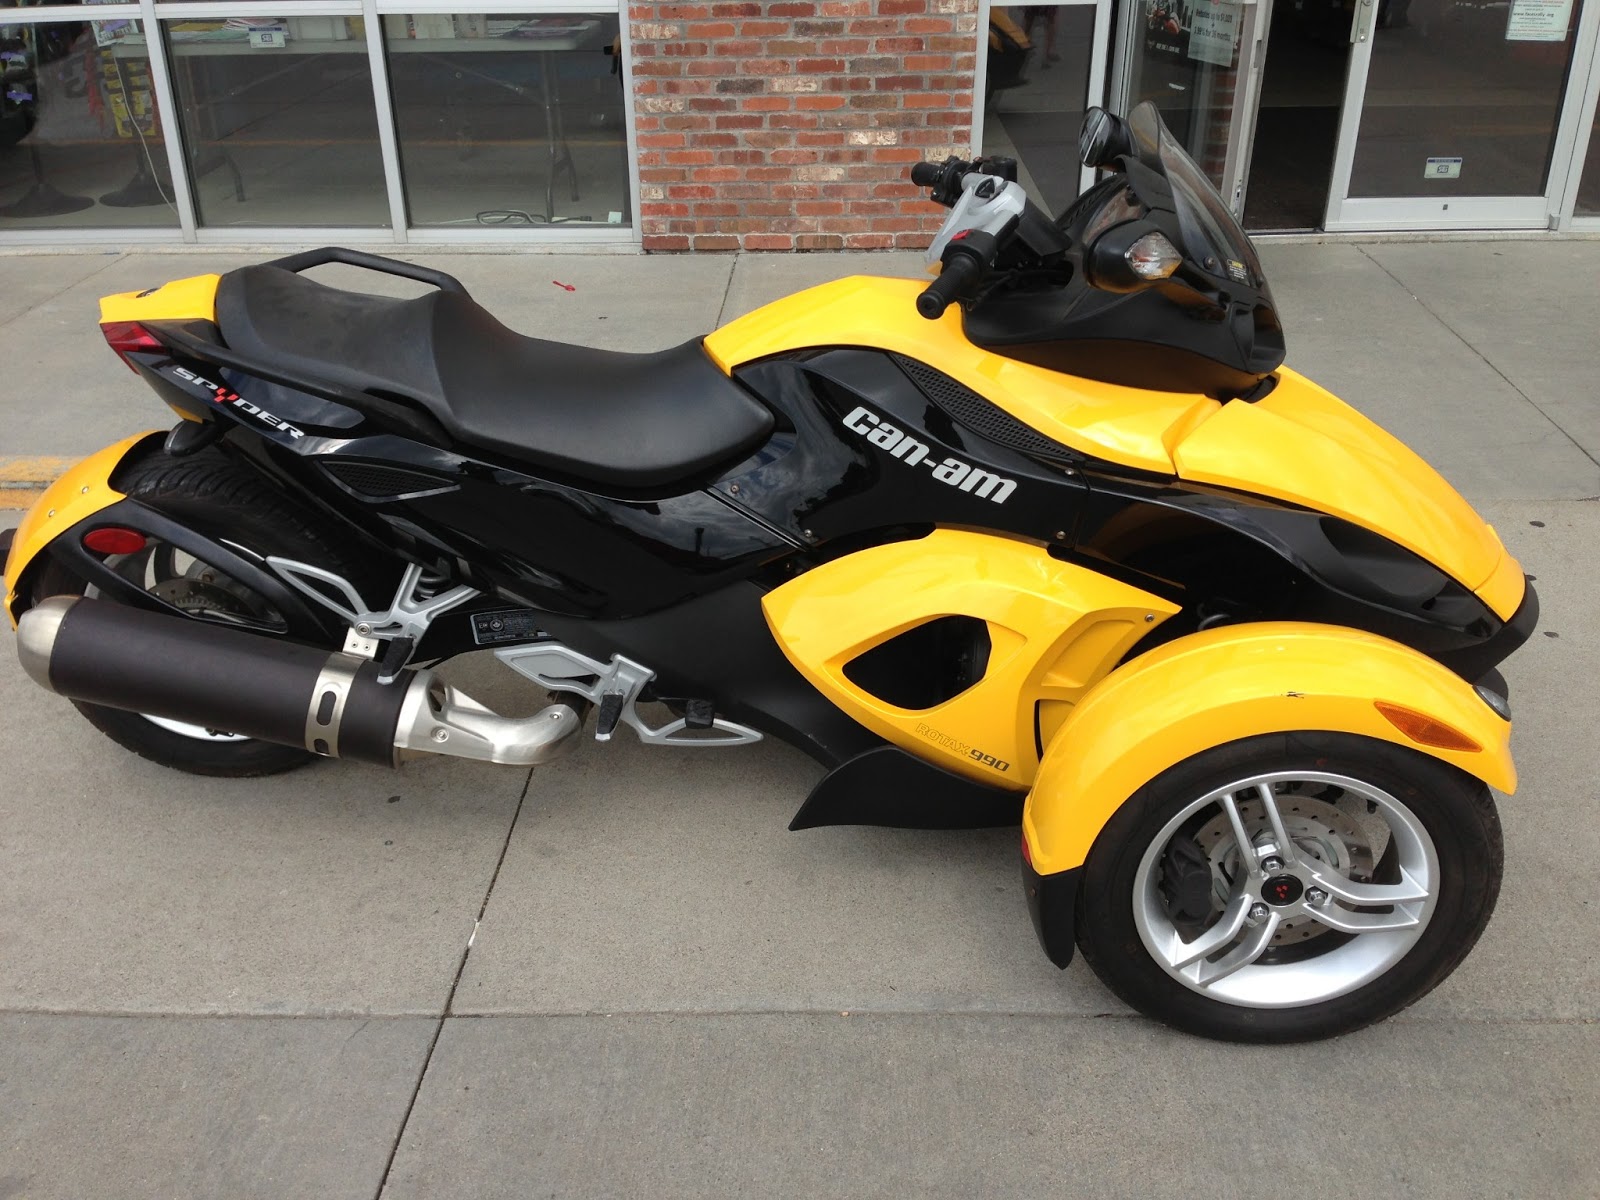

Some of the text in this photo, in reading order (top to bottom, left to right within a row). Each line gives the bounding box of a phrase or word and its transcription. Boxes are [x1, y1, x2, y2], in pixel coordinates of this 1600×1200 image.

[173, 367, 305, 439] SPYDER
[916, 723, 1010, 772] ROTAX 990
